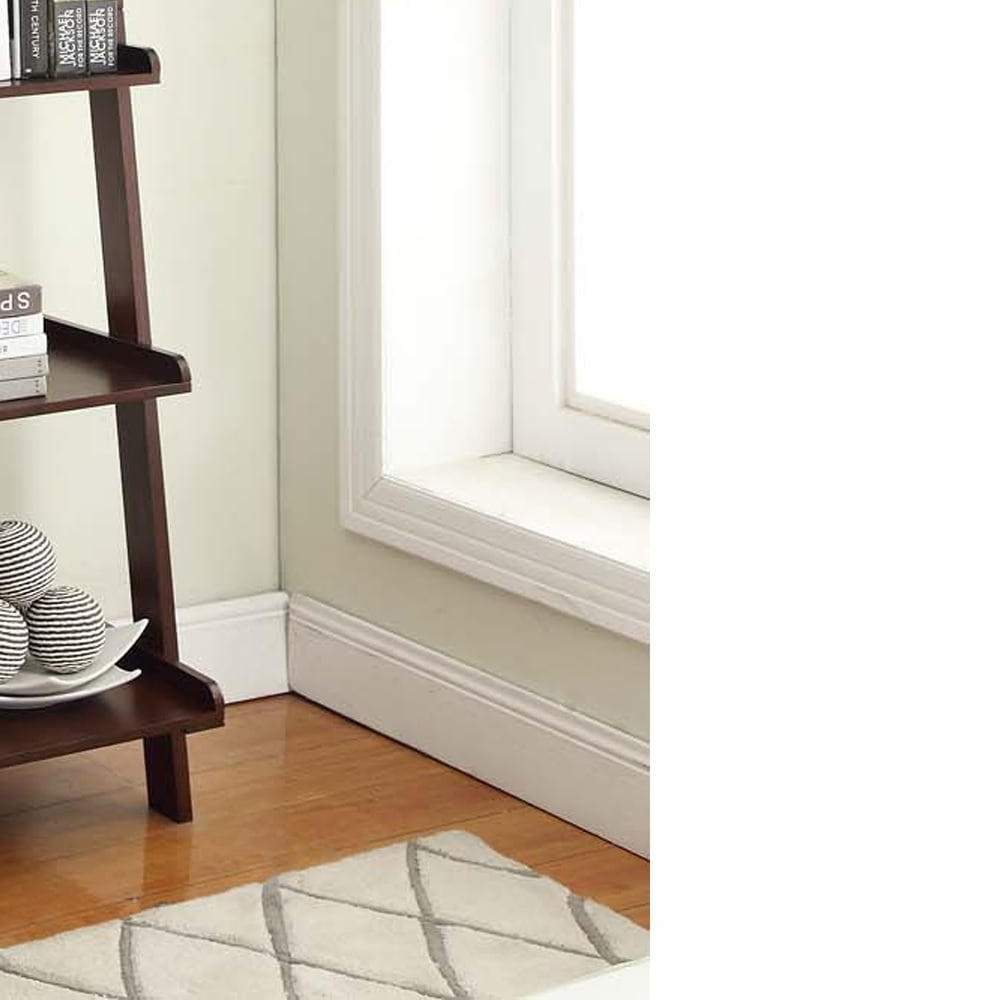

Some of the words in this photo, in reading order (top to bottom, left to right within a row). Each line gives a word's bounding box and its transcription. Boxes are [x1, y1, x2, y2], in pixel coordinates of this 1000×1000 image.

[31, 15, 40, 59] CENTURY
[58, 13, 68, 65] MICHAEL
[64, 9, 76, 67] JACKSON
[88, 12, 99, 63] MICHAEL
[95, 8, 106, 66] JACKSON
